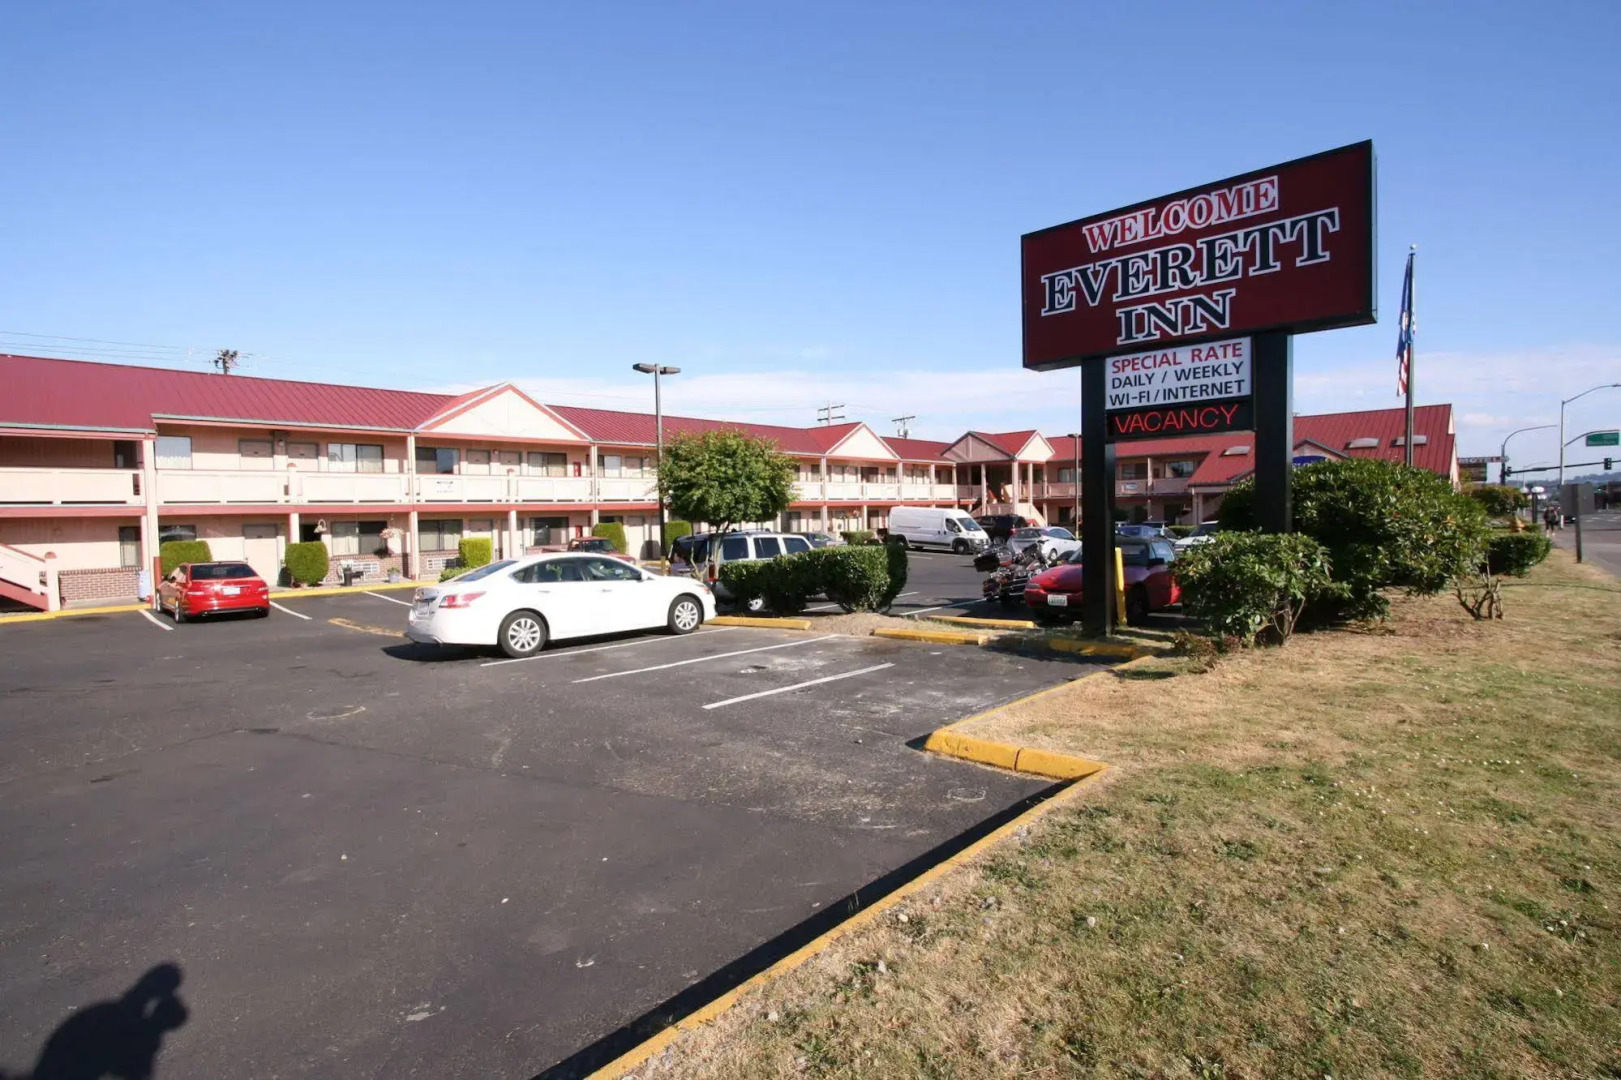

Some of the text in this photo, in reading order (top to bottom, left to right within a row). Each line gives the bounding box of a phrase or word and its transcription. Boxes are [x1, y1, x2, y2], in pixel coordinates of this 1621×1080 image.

[1082, 175, 1279, 253] WELCOME
[1041, 207, 1340, 317] EVERETT
[1116, 288, 1236, 345] INN
[1111, 342, 1243, 374] SPECIAL RATE
[1111, 372, 1155, 390] DAILY
[1174, 361, 1244, 382] WEEKLY
[1115, 404, 1239, 434] VACANCY
